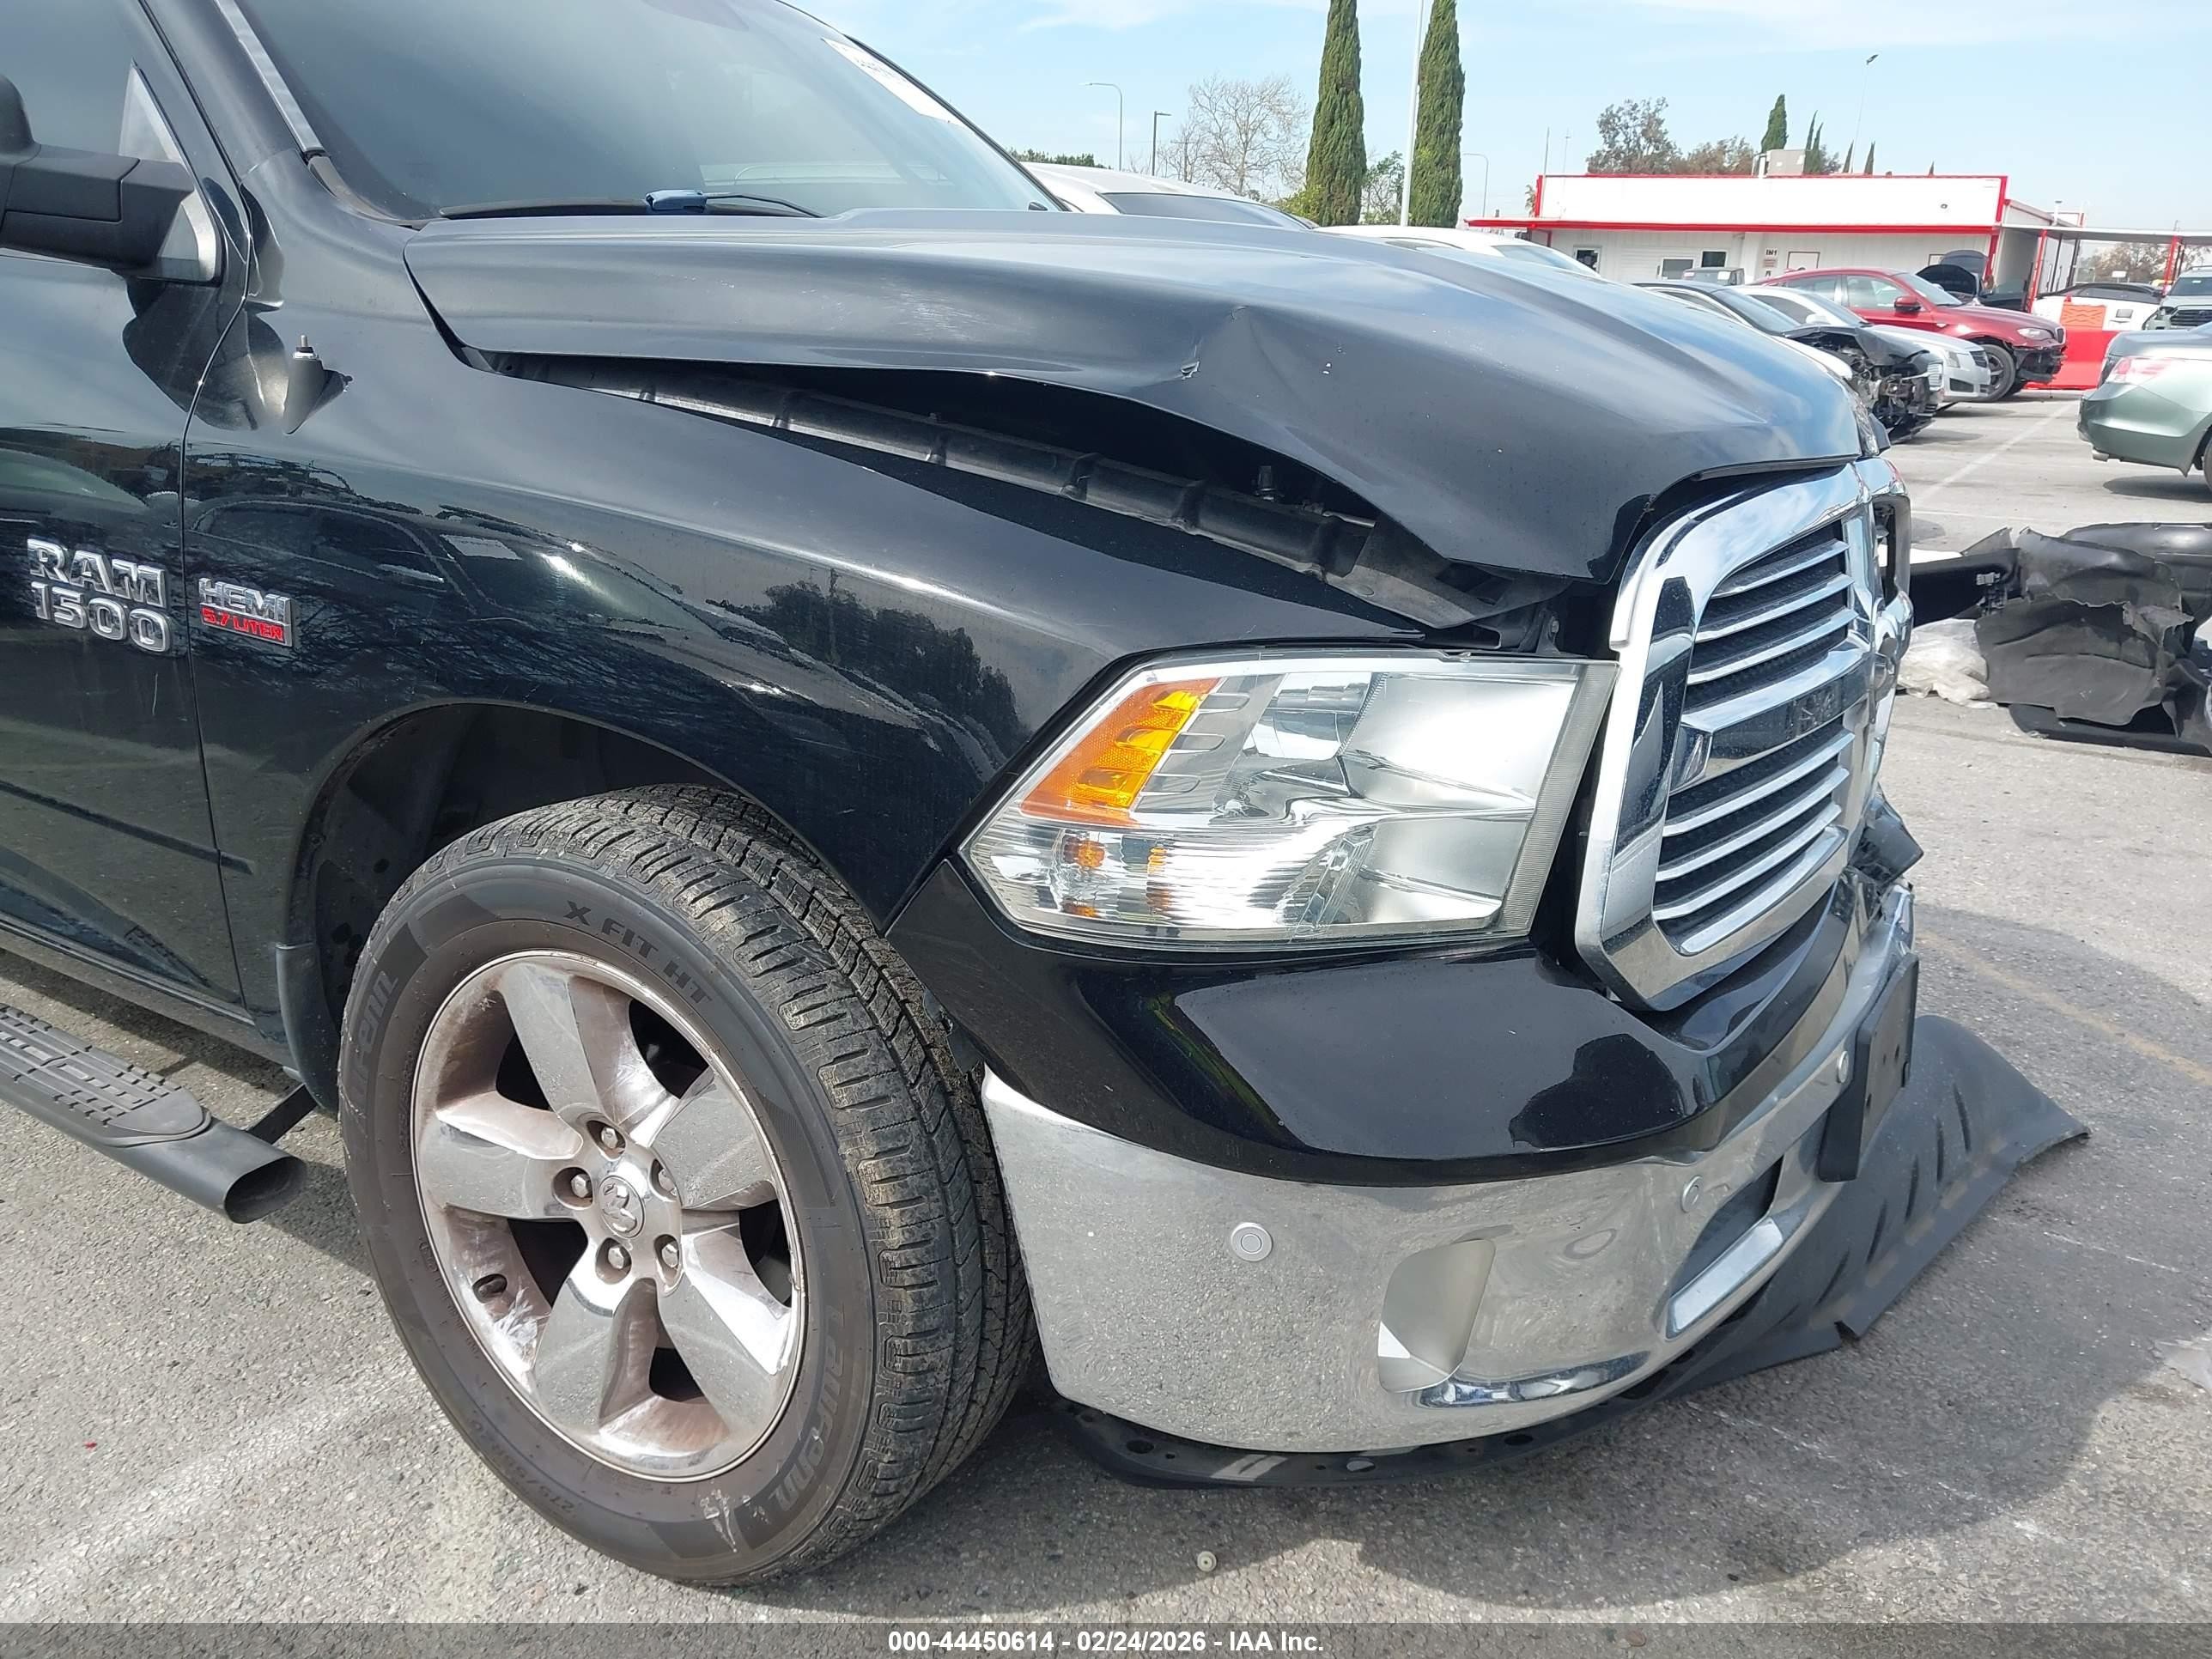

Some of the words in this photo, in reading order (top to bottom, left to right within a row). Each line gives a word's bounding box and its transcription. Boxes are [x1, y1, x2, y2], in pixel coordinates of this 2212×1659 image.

[27, 538, 167, 608] RAM
[198, 577, 292, 624] HEMI
[31, 580, 171, 653] 1500
[201, 605, 229, 627] 5.7
[233, 615, 284, 642] LITER
[563, 900, 592, 927] X
[600, 917, 659, 959] FIT
[663, 960, 712, 1004] HT
